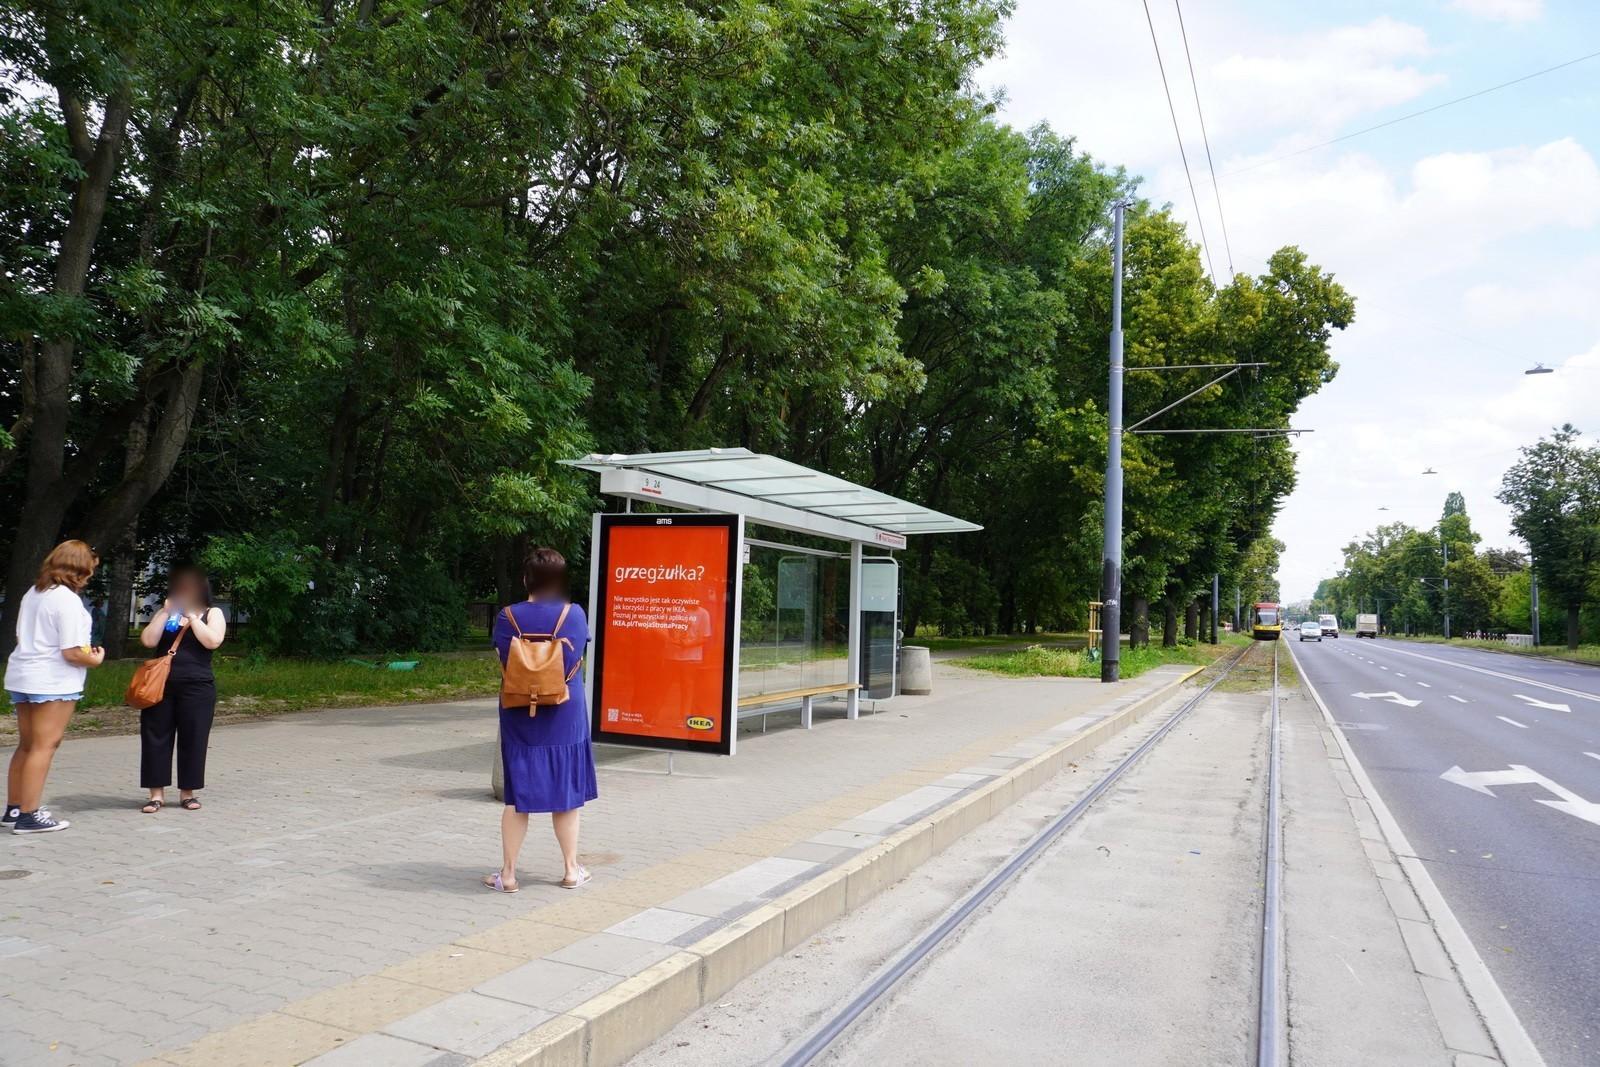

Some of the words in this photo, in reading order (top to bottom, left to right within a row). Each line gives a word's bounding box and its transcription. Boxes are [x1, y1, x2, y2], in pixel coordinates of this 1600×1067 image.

[615, 564, 705, 583] grzegżułka?
[671, 598, 700, 606] oczywiste
[613, 603, 621, 611] jak
[612, 611, 631, 621] Poznaj
[638, 613, 665, 621] wszystkie
[612, 619, 689, 631] IKEA.pl/TwojaStronaPracy
[689, 719, 711, 727] IKEA
